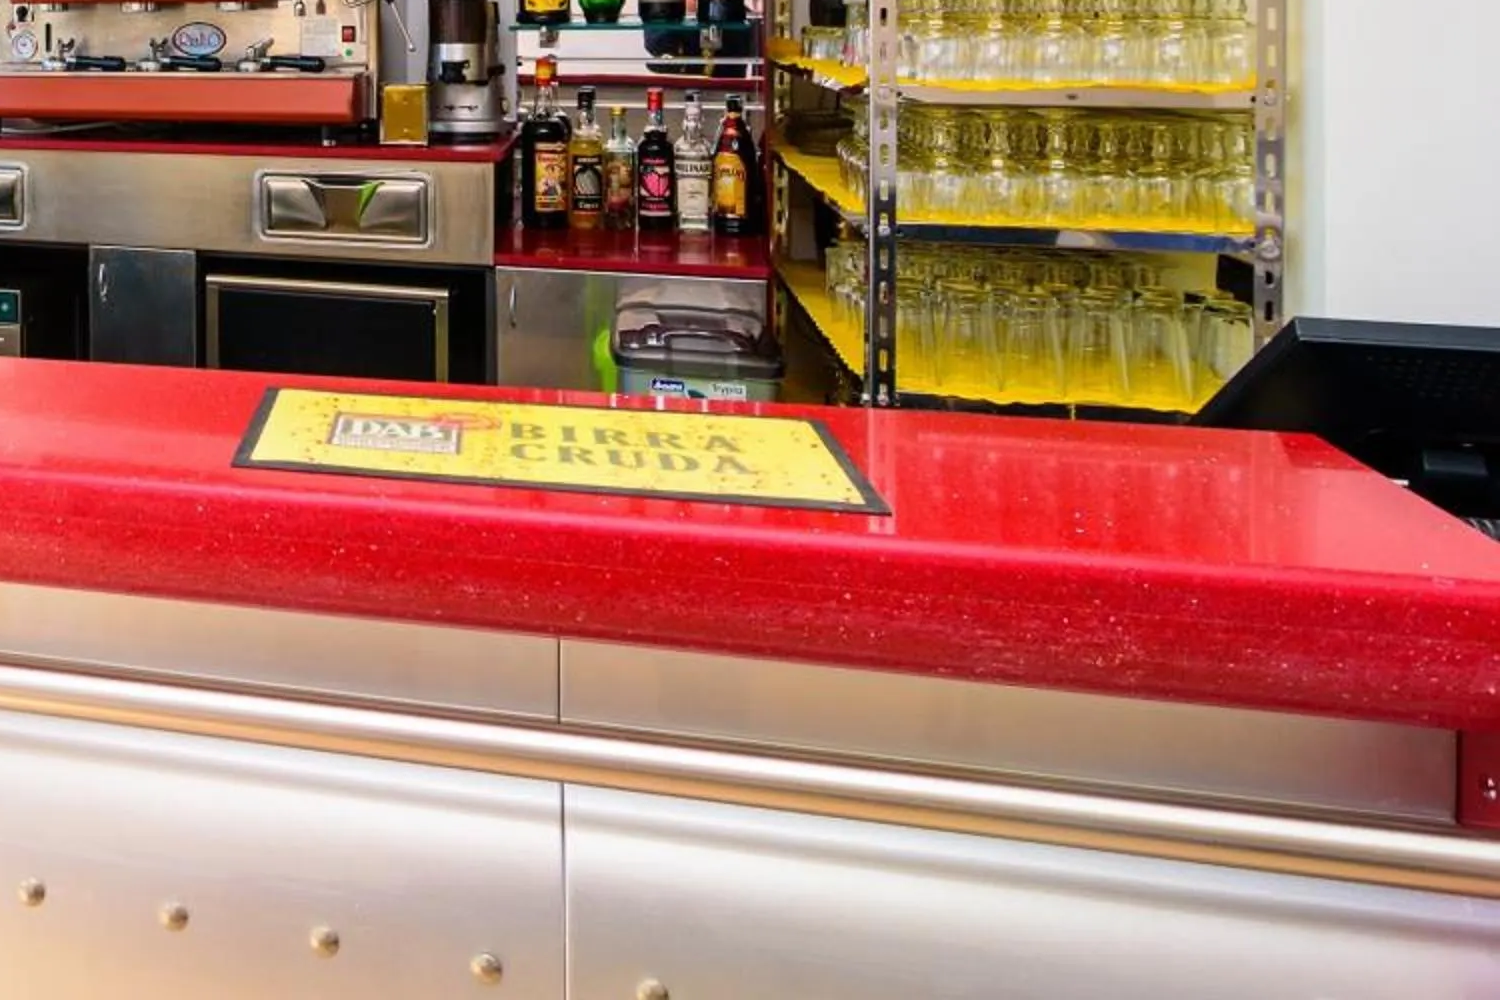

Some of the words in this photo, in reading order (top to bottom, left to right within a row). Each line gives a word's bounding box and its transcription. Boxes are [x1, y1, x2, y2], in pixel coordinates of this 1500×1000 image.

[350, 418, 445, 439] DAB
[511, 423, 740, 452] BIRRA
[511, 443, 754, 474] CRUDA
